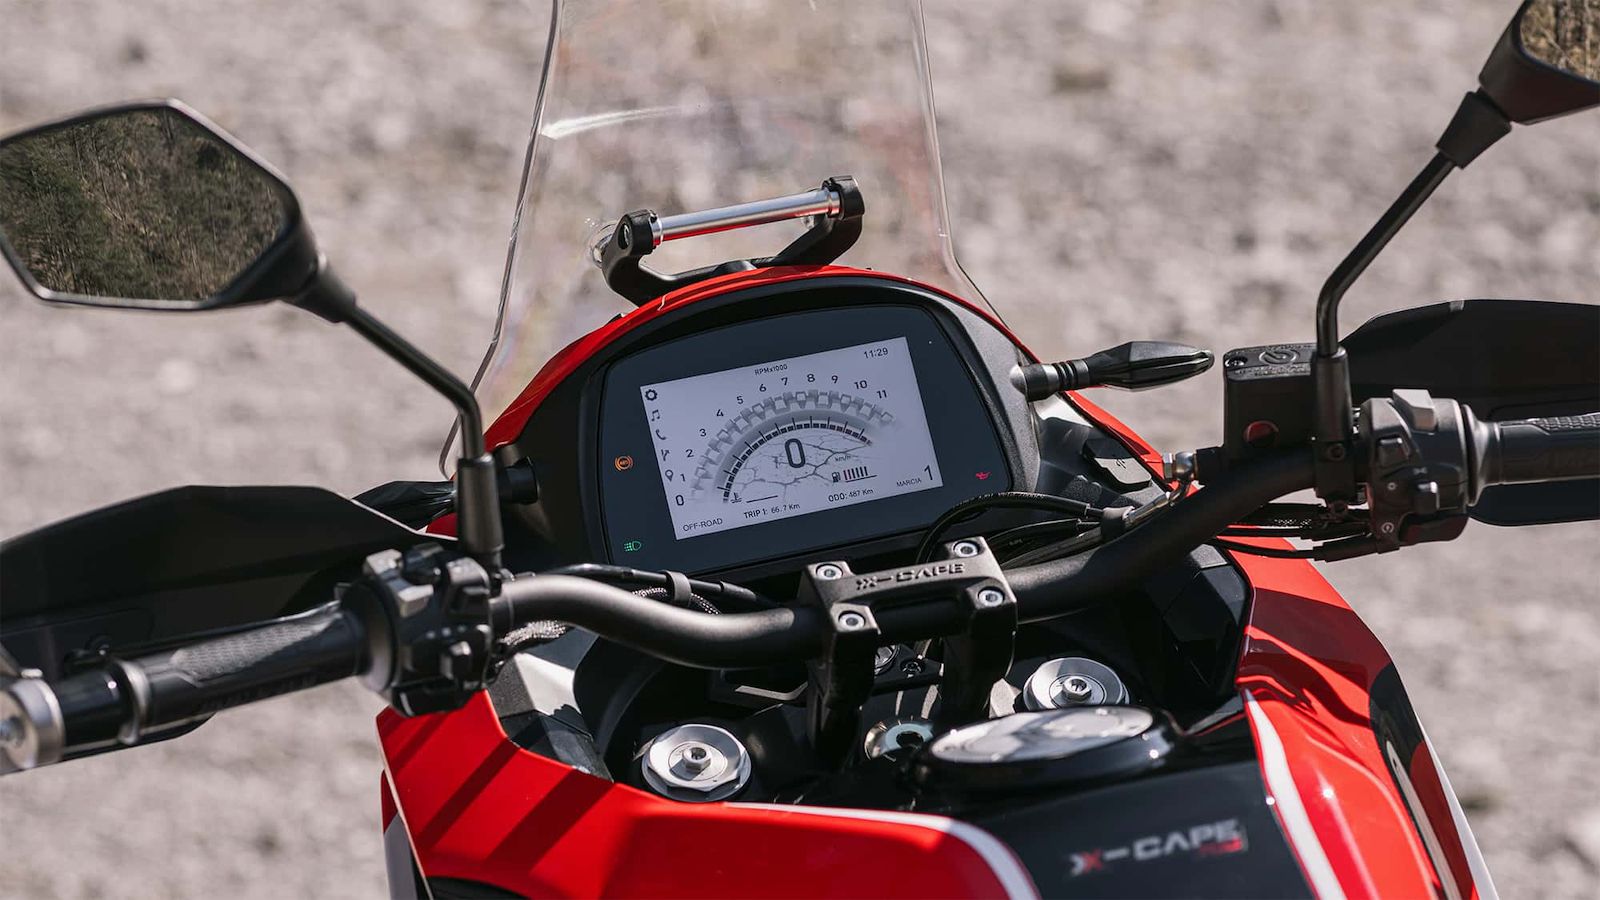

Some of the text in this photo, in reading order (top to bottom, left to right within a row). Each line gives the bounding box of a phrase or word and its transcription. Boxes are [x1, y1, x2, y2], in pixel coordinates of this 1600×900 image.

[863, 347, 889, 359] 11:29
[754, 363, 788, 376] RPMx1000
[781, 376, 789, 386] 7
[806, 373, 816, 383] 8
[831, 374, 839, 384] 9
[759, 383, 767, 392] 6
[854, 379, 868, 390] 10
[876, 389, 887, 399] 11
[736, 395, 744, 405] 5
[716, 408, 724, 417] 4
[699, 428, 707, 437] 3
[685, 448, 694, 458] 2
[784, 438, 806, 469] 0
[680, 473, 686, 482] 1
[896, 465, 933, 488] MARCIA 1
[675, 494, 685, 506] 0
[744, 510, 761, 519] TRIP
[762, 508, 768, 516] 1:
[789, 503, 801, 511] Km
[683, 518, 723, 532] OFF-ROAD
[856, 563, 965, 591] X-CAPE
[1070, 819, 1240, 877] X-CAPE
